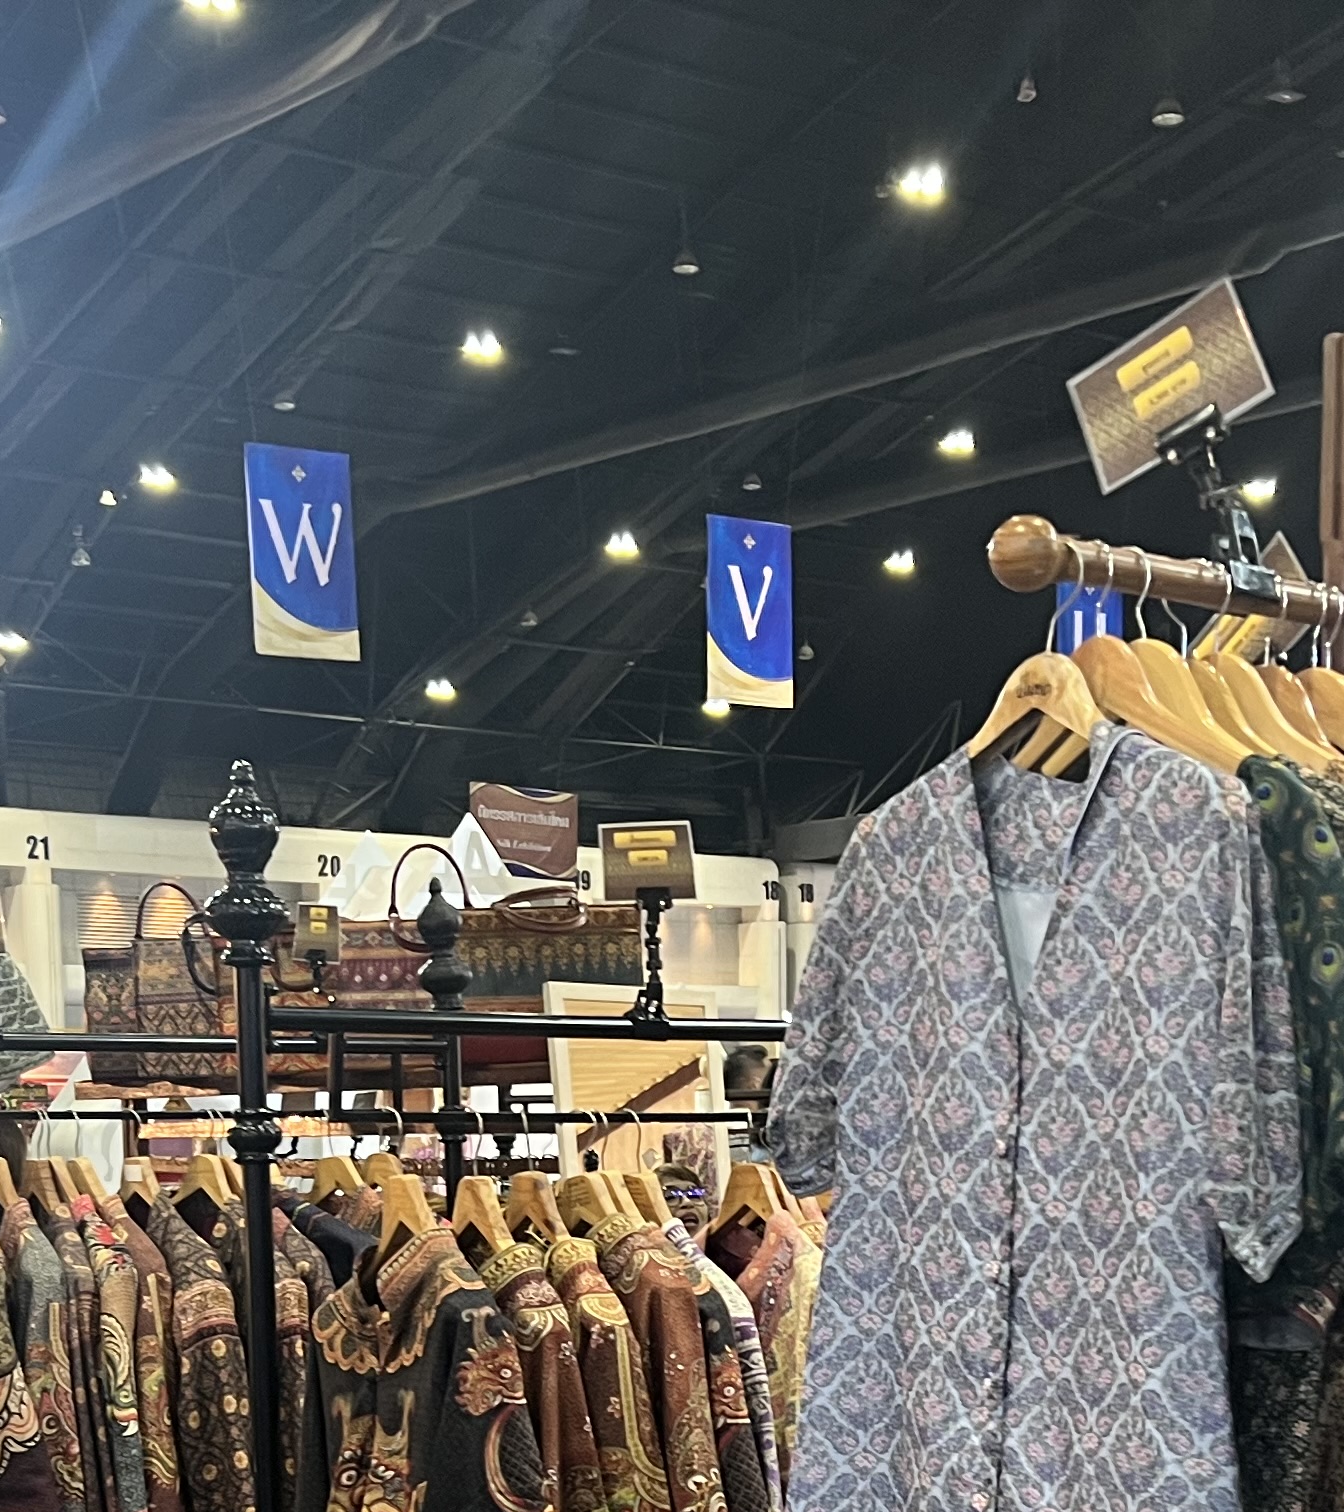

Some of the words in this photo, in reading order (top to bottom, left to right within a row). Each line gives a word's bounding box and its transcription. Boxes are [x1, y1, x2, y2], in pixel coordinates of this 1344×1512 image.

[258, 498, 343, 587] W
[727, 564, 774, 642] V
[26, 834, 50, 861] 21
[317, 854, 341, 878] 20
[762, 880, 780, 901] 18
[798, 882, 815, 903] 18
